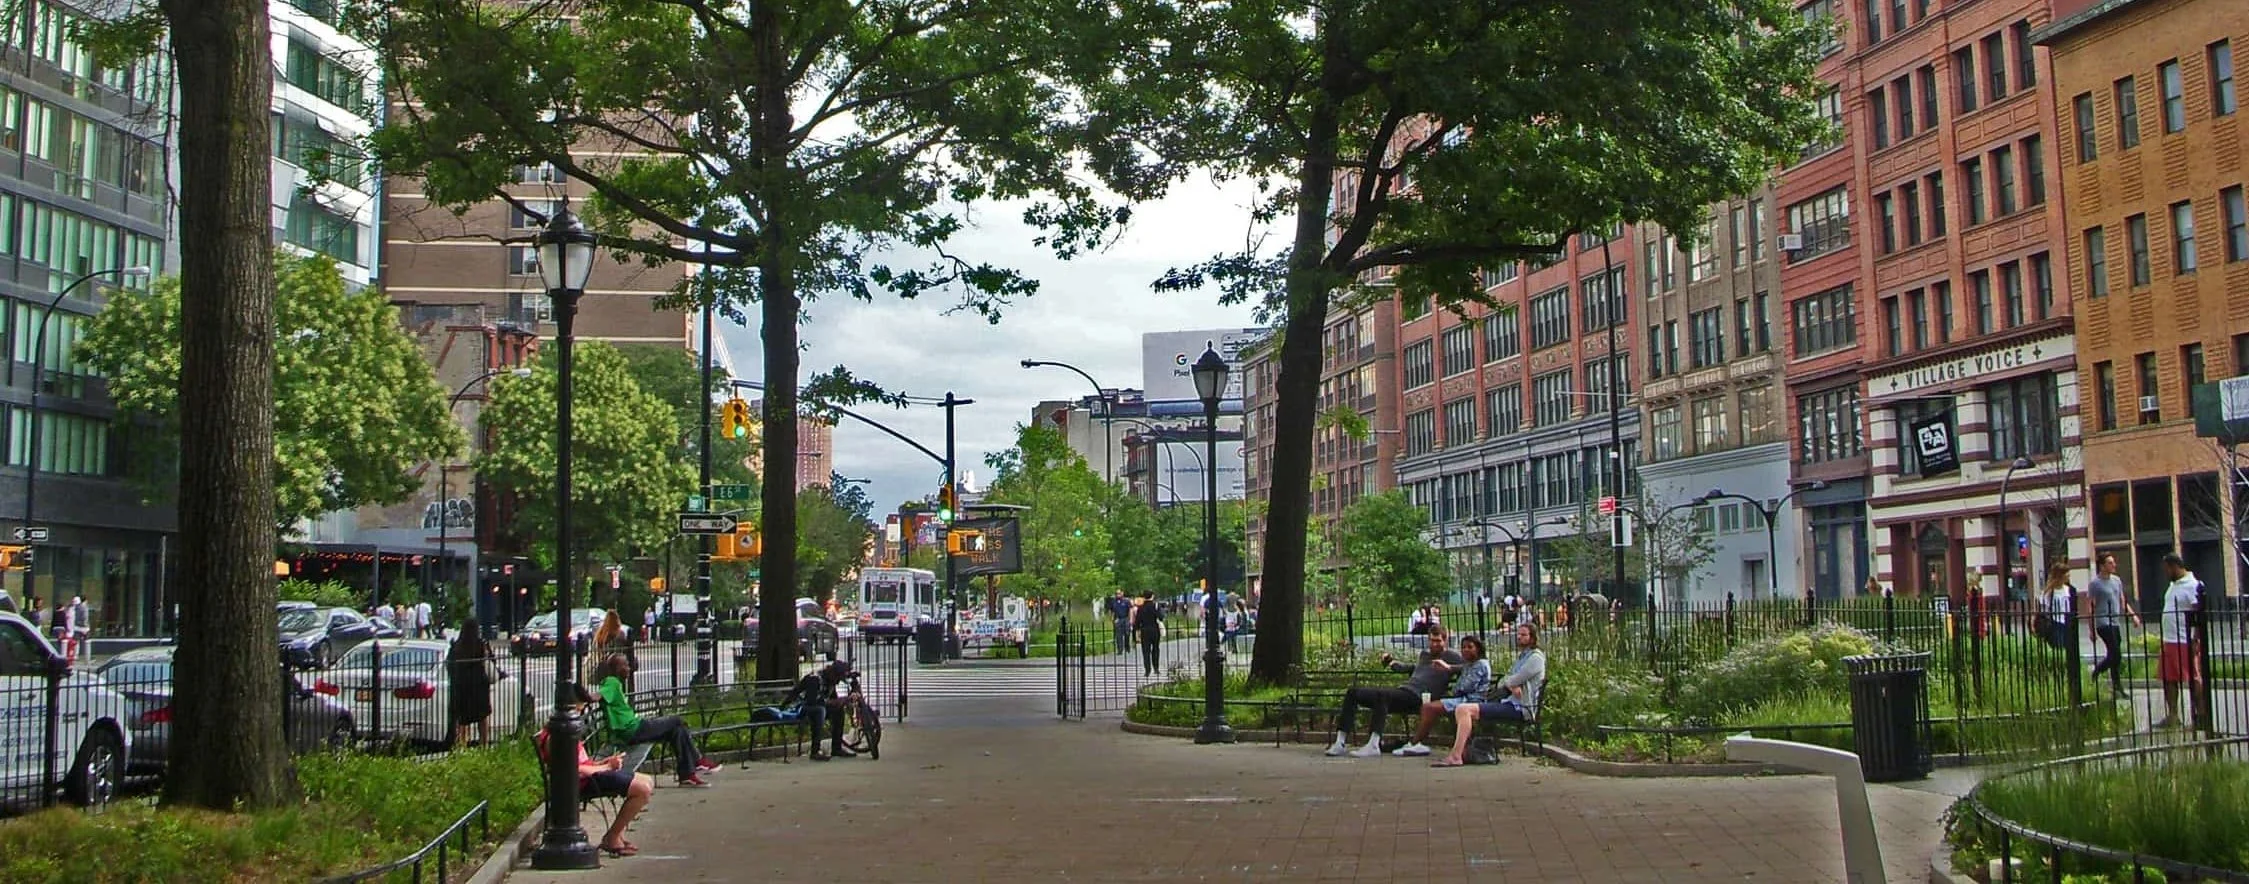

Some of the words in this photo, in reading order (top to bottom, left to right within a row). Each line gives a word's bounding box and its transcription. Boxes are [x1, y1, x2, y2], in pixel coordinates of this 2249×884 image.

[1906, 361, 1966, 389] VILLAGE
[1975, 348, 2023, 373] VOICE
[684, 520, 702, 528] ONE
[711, 520, 729, 528] WAY
